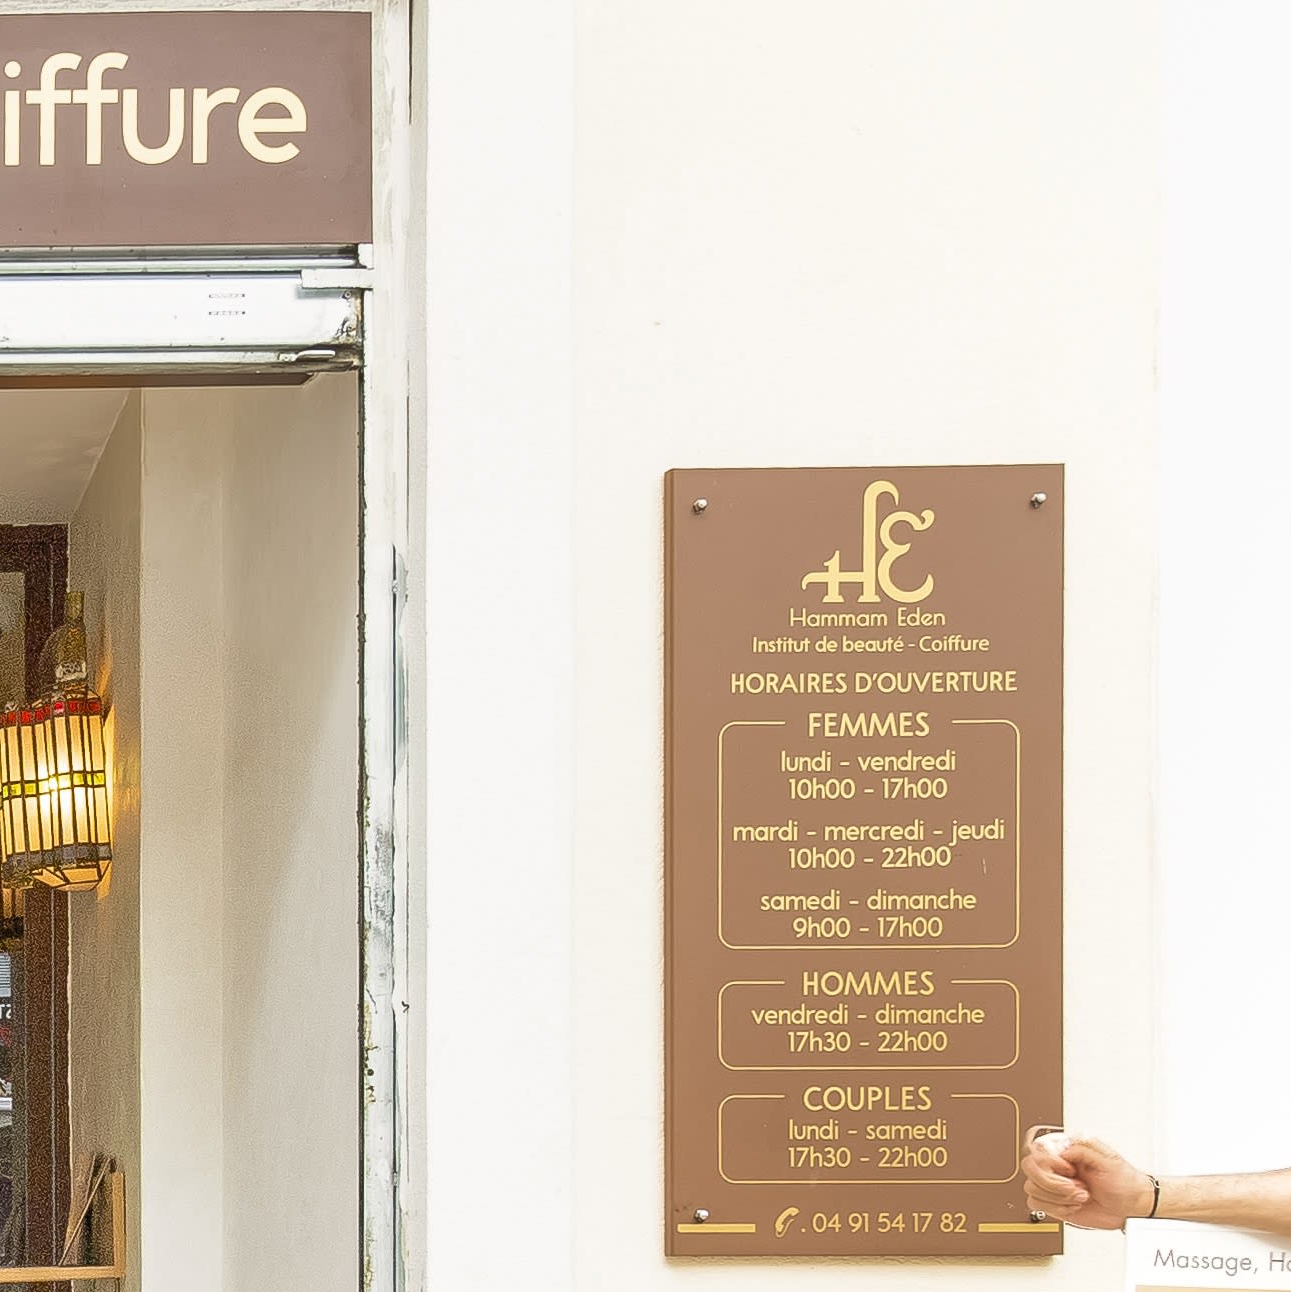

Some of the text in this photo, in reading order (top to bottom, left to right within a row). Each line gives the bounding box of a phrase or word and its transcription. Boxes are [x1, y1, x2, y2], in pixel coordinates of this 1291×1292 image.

[790, 607, 945, 627] Hammam Eden
[753, 637, 810, 652] Institut
[815, 636, 838, 652] de
[843, 636, 904, 652] beauté
[919, 635, 989, 651] Coiffure
[732, 671, 1017, 693] HORAIRES D'OUVERTURE
[809, 712, 929, 737] FEMMES
[782, 750, 831, 771] lundi
[858, 749, 955, 771] vendredi
[789, 777, 855, 799] 10h00
[882, 777, 947, 798] 17h00
[734, 820, 797, 841] mardi
[825, 819, 924, 840] mercredi
[949, 818, 1004, 846] jeudi
[789, 847, 855, 868] 10h00
[882, 845, 951, 867] 22h00
[761, 889, 840, 910] samedi
[867, 888, 976, 910] dimanche
[793, 916, 850, 937] 9h00
[878, 916, 943, 937] 17h00
[804, 971, 934, 995] HOMMES
[751, 1003, 848, 1024] vendredi
[875, 1003, 985, 1024] dimanche
[788, 1030, 851, 1052] 17h30
[878, 1030, 947, 1051] 22h00
[804, 1086, 931, 1111] COUPLES
[790, 1119, 838, 1139] lundi
[866, 1119, 946, 1139] samedi
[788, 1146, 850, 1167] 17h30
[878, 1146, 947, 1167] 22h00
[813, 1213, 967, 1232] 04 91 54 17 82
[1154, 1249, 1258, 1276] Massage,
